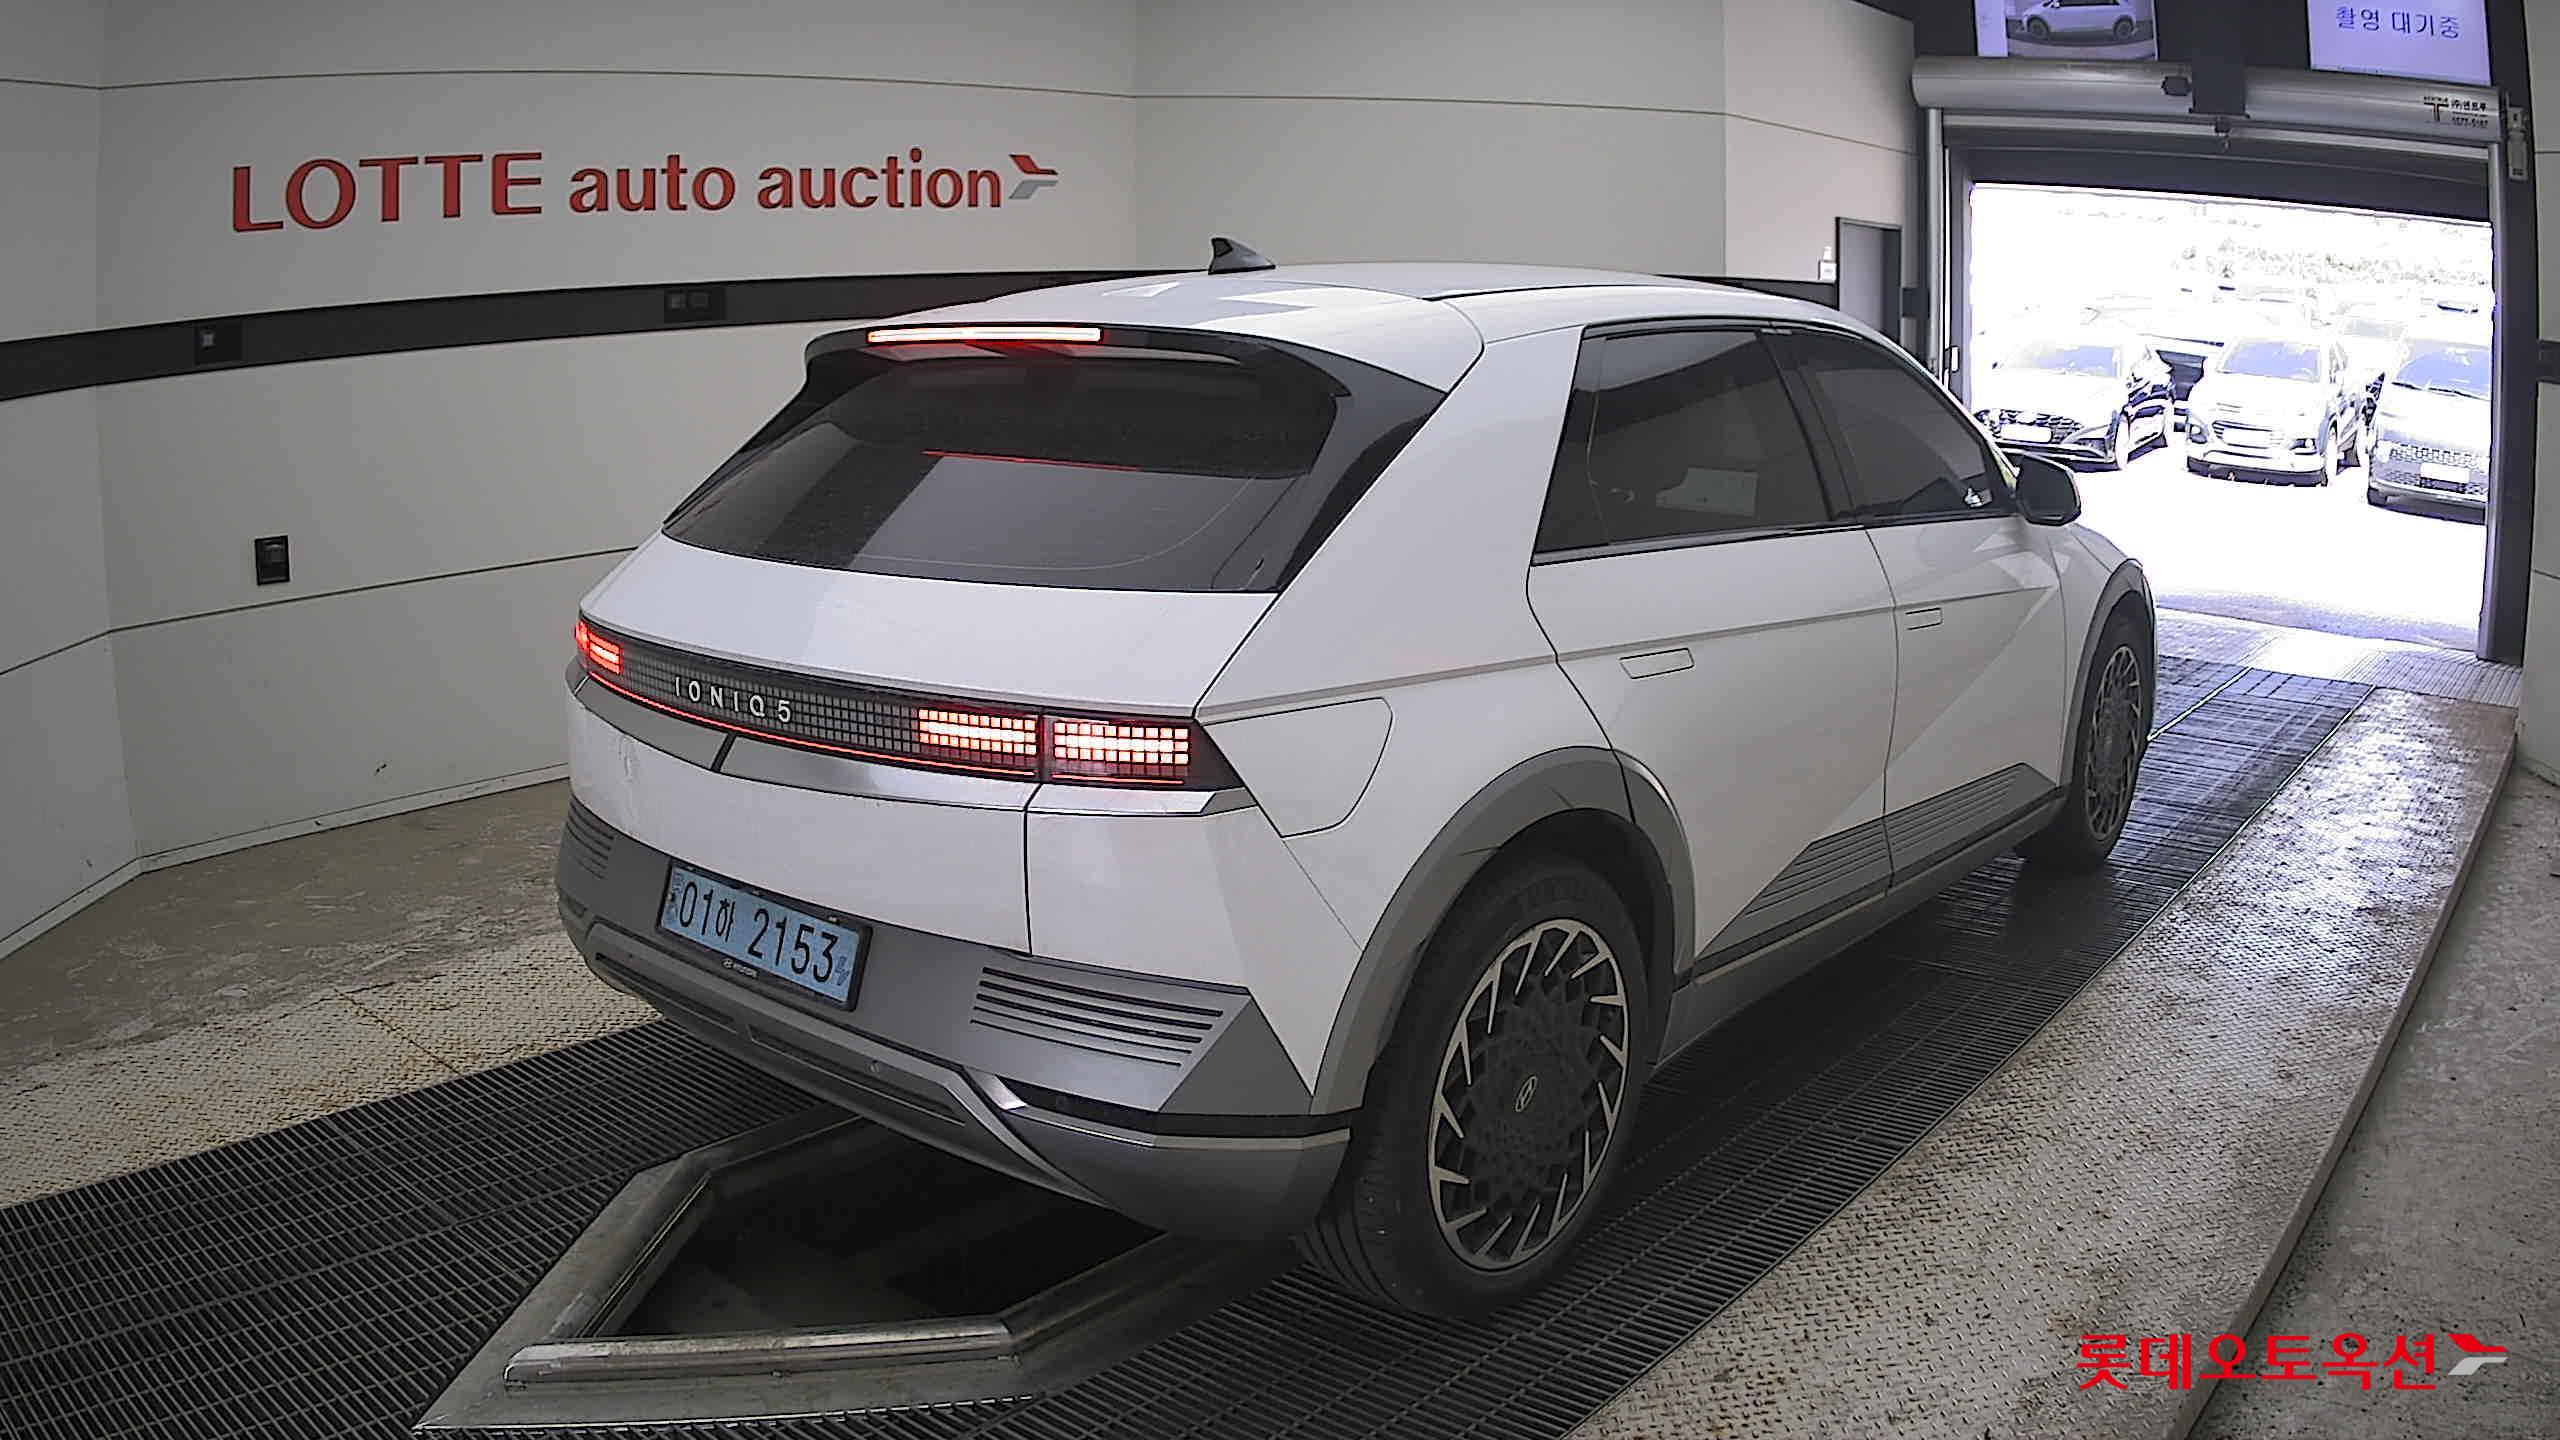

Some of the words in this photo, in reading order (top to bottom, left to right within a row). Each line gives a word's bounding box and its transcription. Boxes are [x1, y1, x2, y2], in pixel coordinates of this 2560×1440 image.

[2336, 6, 2380, 31] 촬영
[2391, 12, 2459, 39] 대기중
[232, 152, 543, 232] LOTTE
[568, 153, 737, 212] auto
[757, 147, 1002, 209] auction
[675, 676, 765, 717] IONIQ
[778, 699, 791, 723] 5
[679, 881, 736, 942] 01하
[747, 908, 839, 983] 2153
